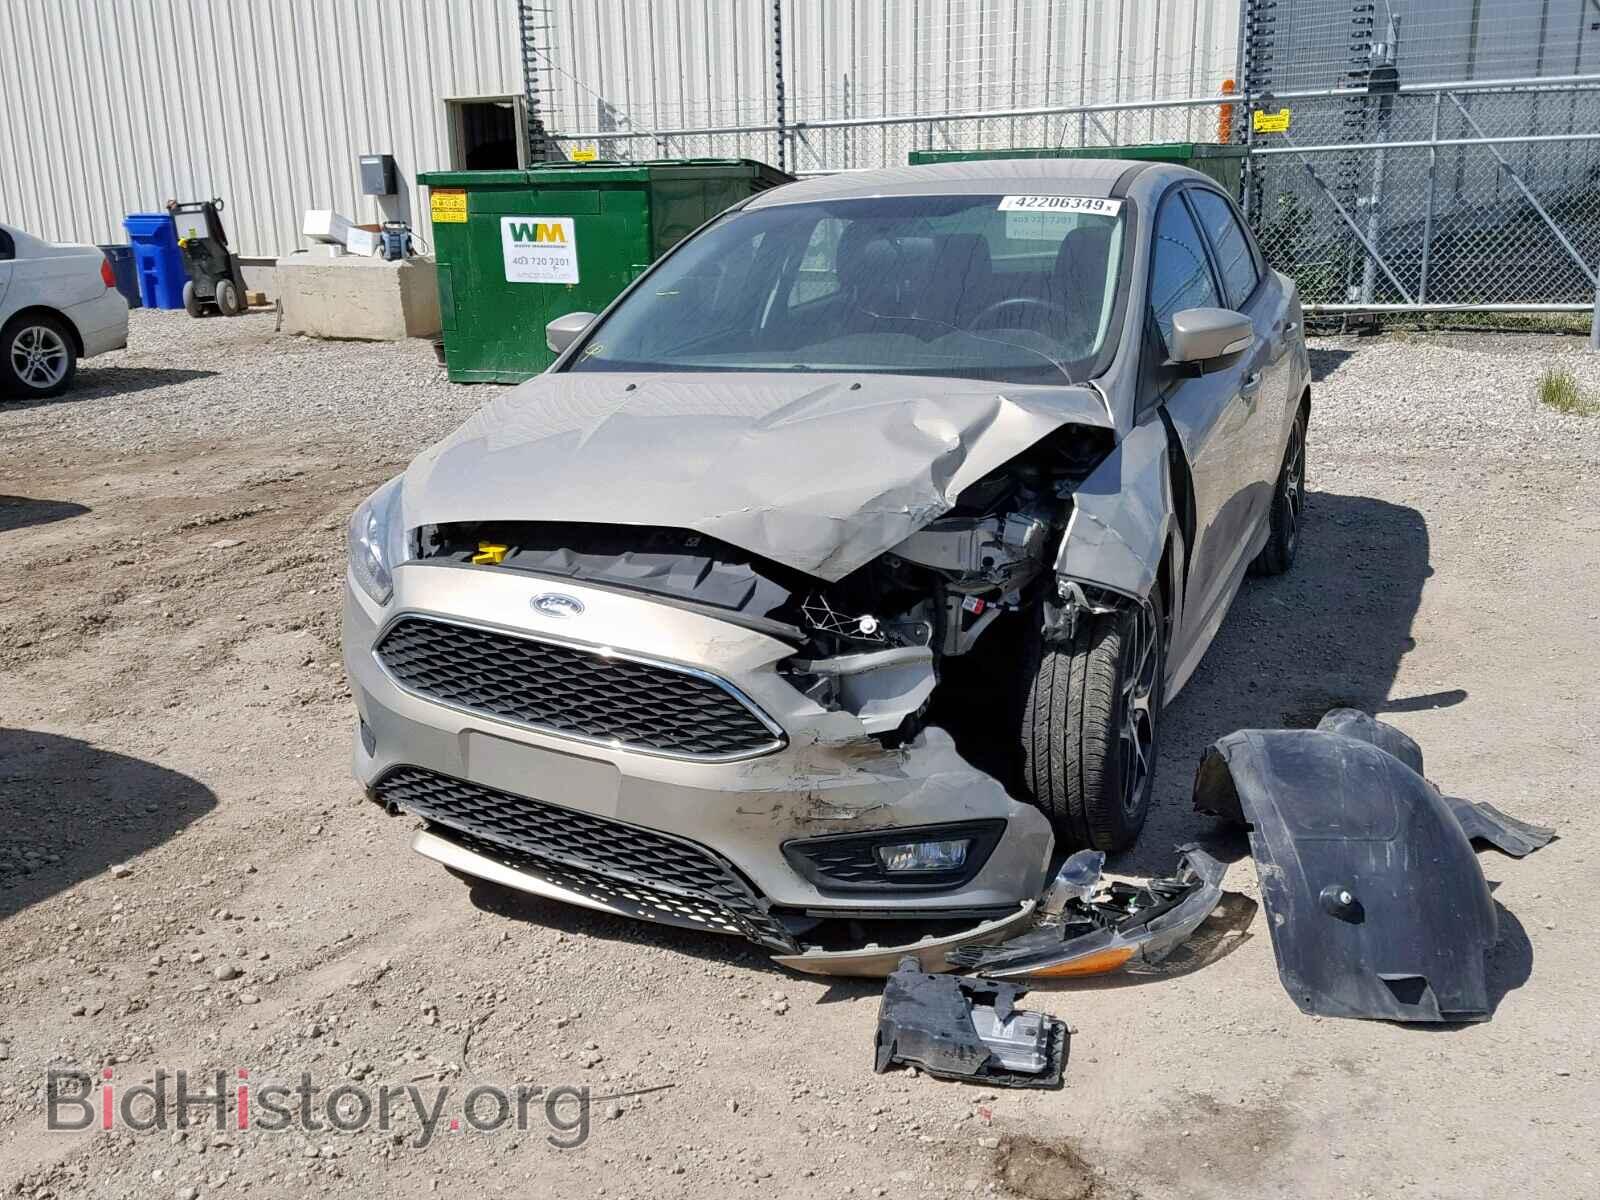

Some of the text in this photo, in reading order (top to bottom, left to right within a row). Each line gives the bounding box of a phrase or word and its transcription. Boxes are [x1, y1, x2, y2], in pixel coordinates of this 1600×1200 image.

[1015, 197, 1105, 211] 42206349
[509, 223, 566, 242] WM
[512, 256, 569, 266] 403 720 7201
